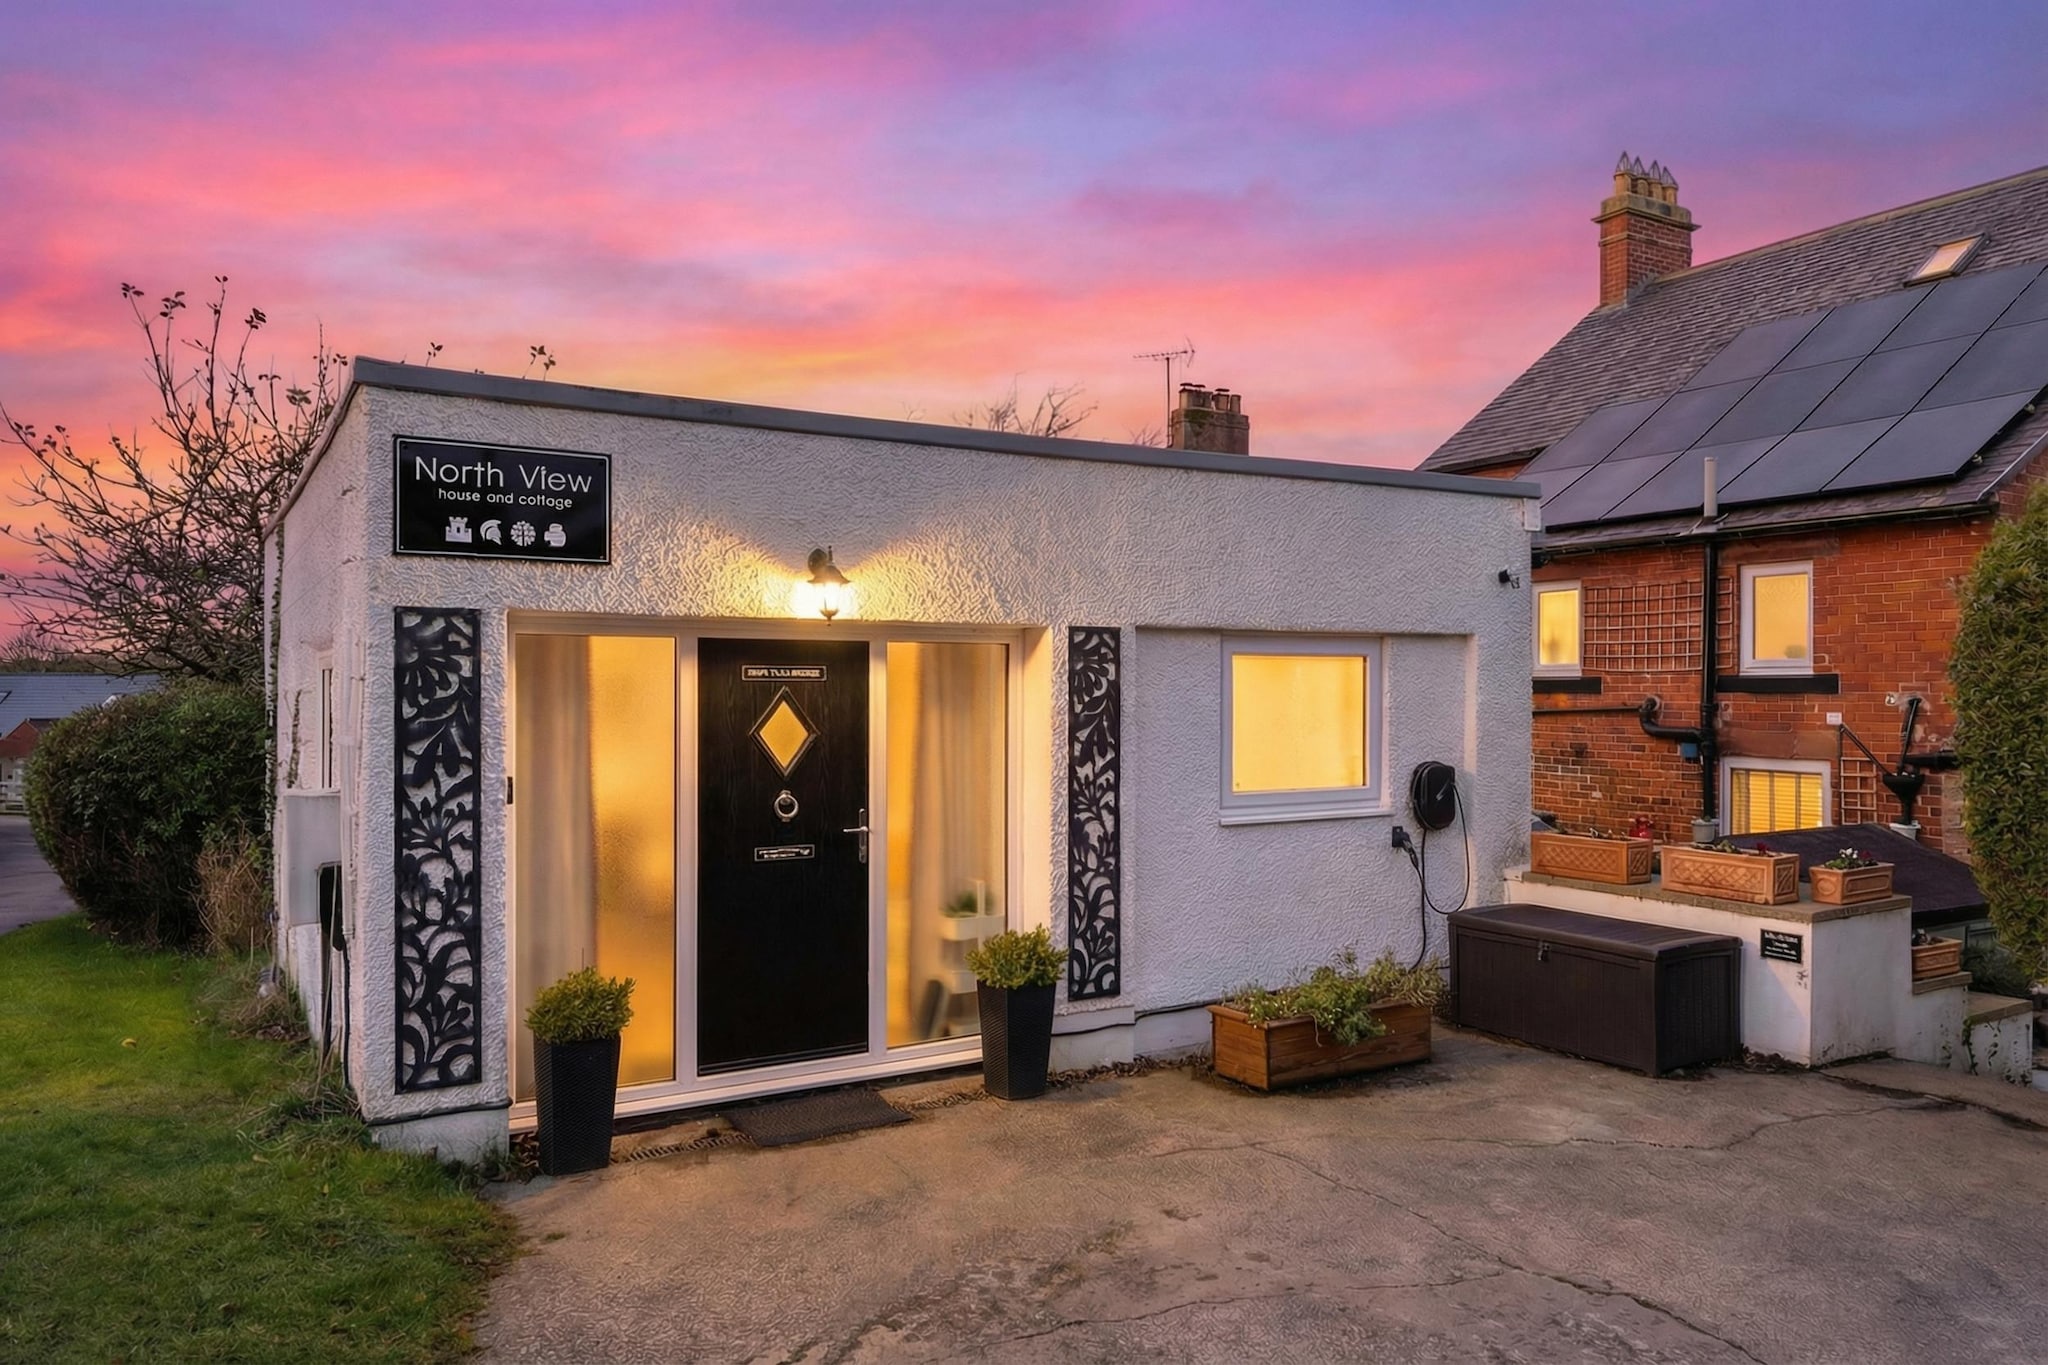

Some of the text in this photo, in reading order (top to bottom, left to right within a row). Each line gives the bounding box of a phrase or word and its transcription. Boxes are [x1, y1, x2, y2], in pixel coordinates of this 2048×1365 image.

[415, 456, 592, 493] North View
[438, 488, 573, 510] house and cottage
